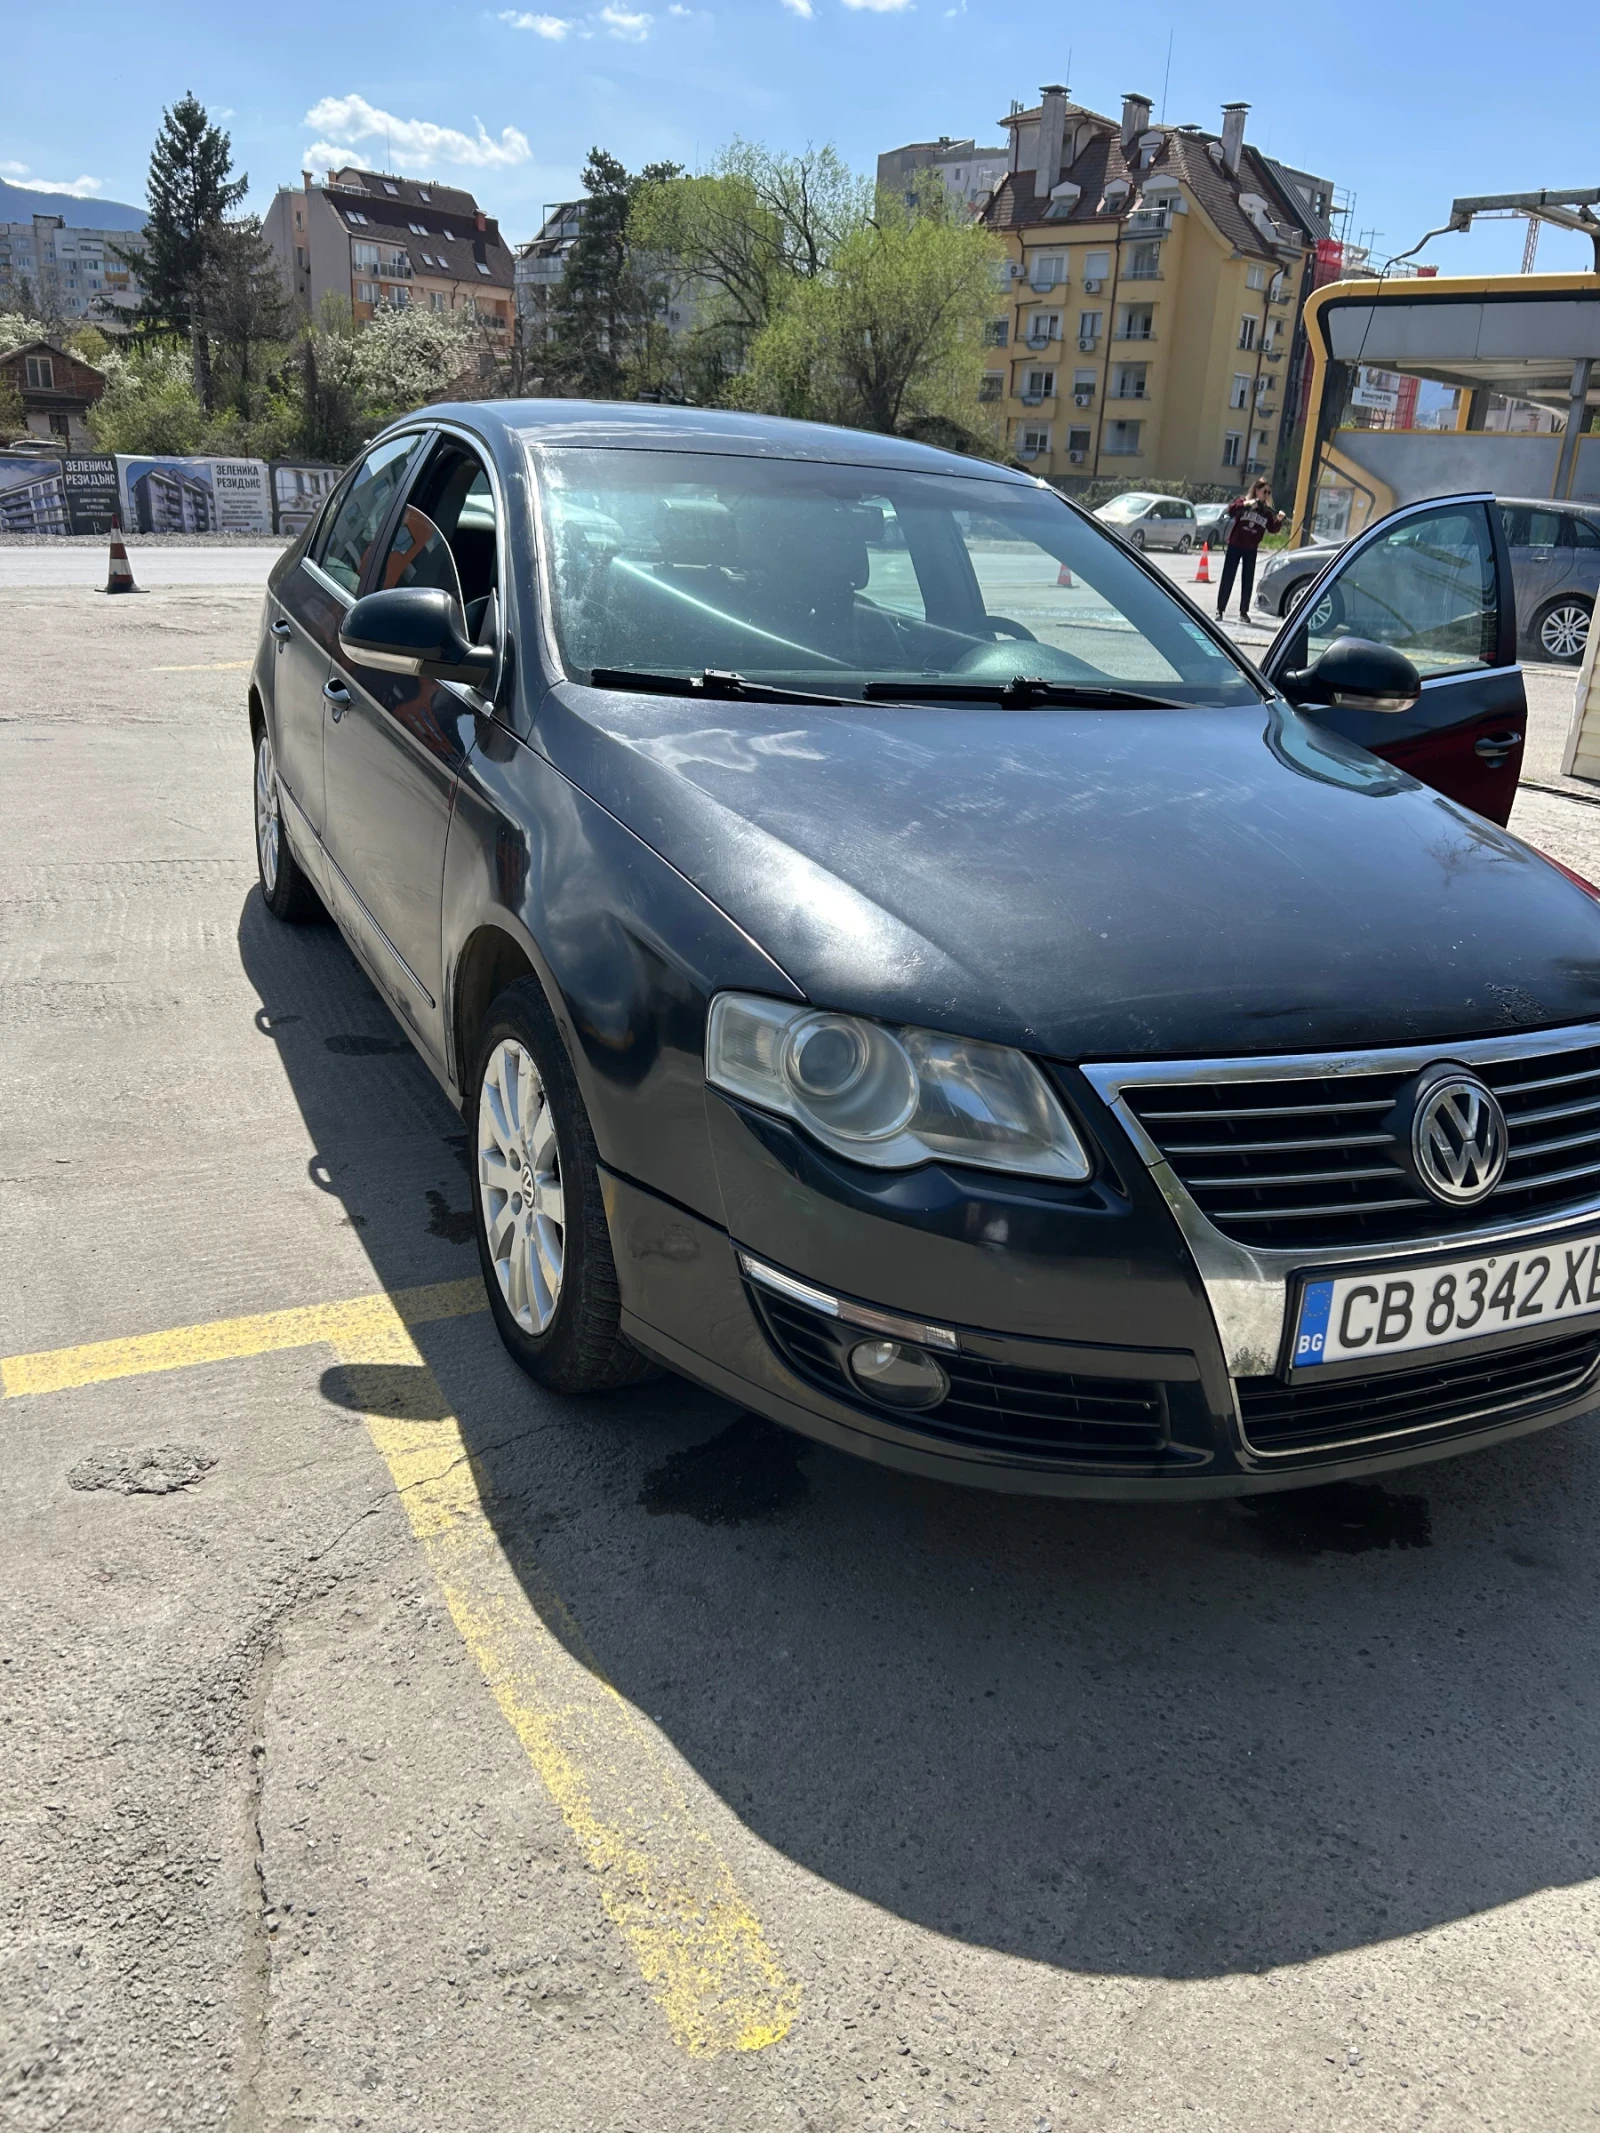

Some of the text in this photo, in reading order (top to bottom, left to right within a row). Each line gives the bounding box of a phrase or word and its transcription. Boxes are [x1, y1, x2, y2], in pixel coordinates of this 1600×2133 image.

[65, 460, 114, 472] ЗЕЛЕНИКА
[216, 465, 259, 476] ЗЕЛЕНИКА
[65, 473, 116, 486] РЕЗИДЪНС
[216, 478, 261, 489] РЕЗИДЪНС
[1338, 1281, 1415, 1349] CB
[1426, 1256, 1551, 1336] 8342
[1297, 1332, 1324, 1354] BG
